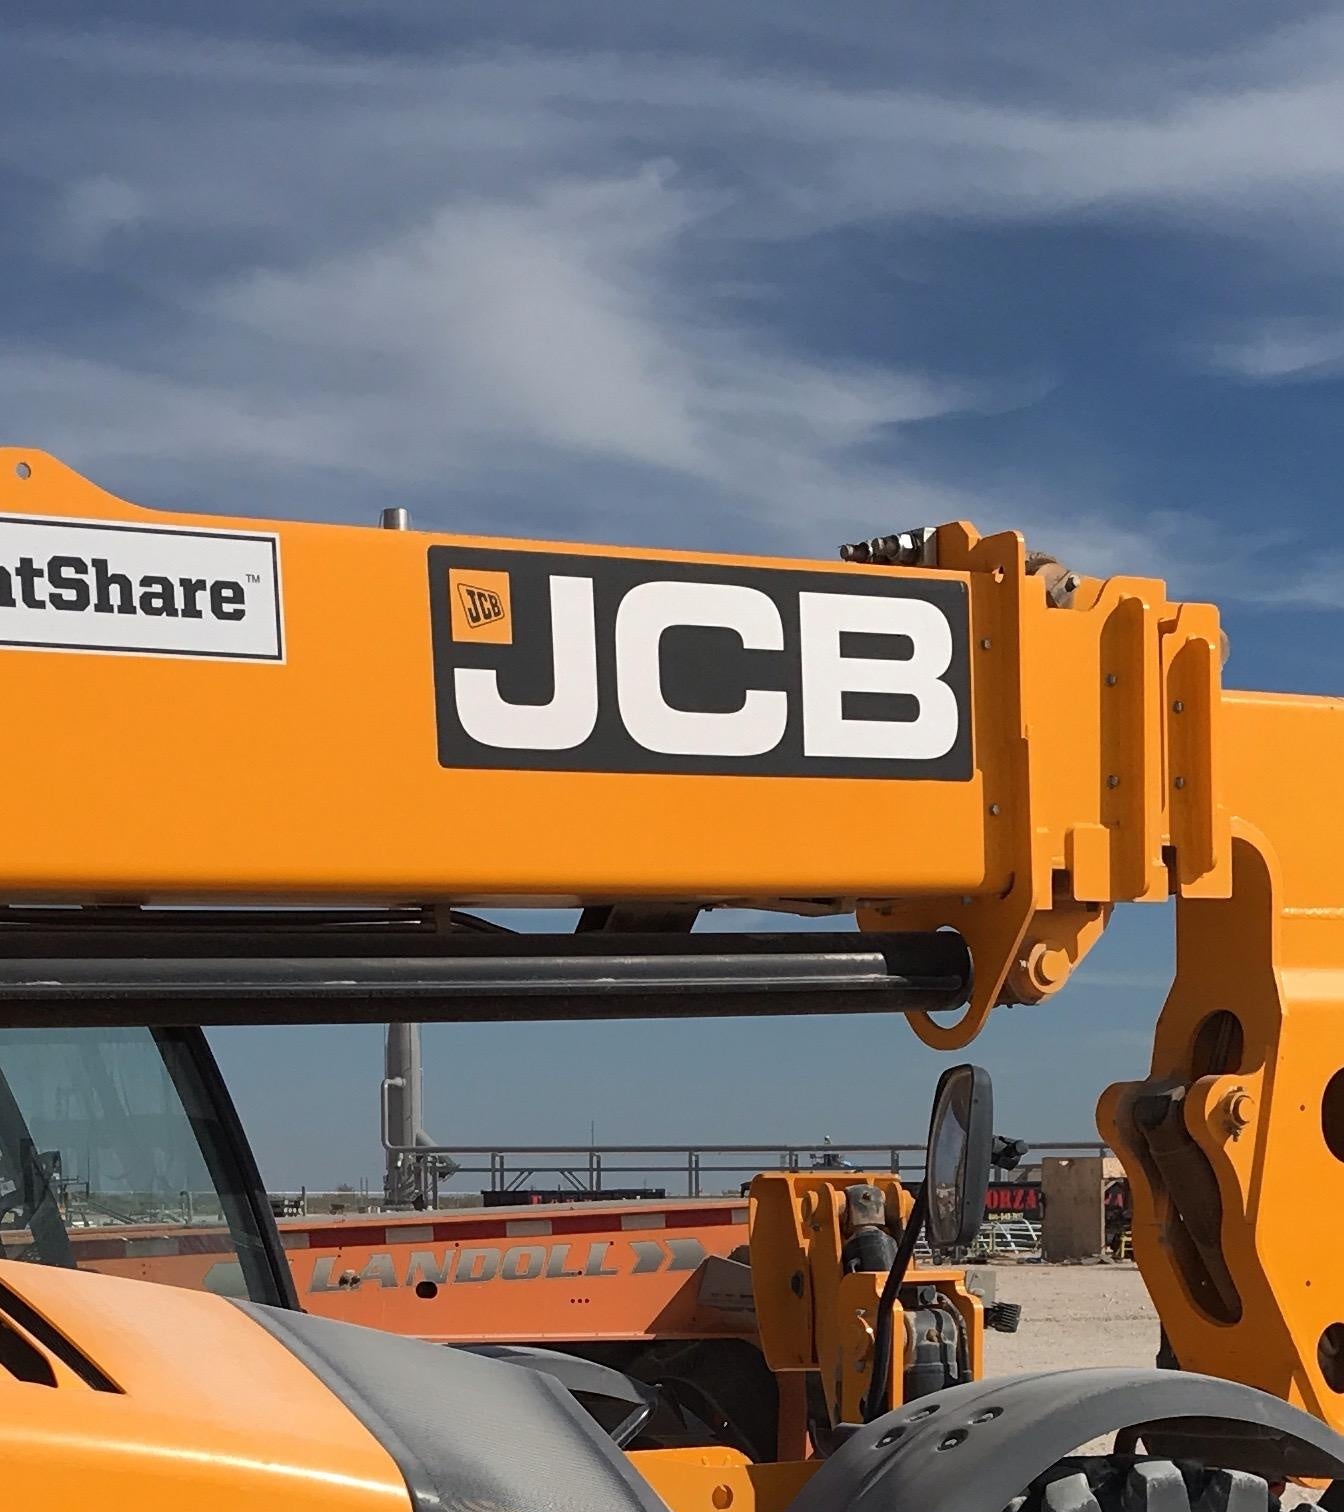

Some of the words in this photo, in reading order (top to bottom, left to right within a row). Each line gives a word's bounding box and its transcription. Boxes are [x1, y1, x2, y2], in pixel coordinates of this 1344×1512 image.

[466, 588, 504, 624] JCB
[453, 575, 959, 760] JCB
[309, 1242, 618, 1293] LANDOLL
